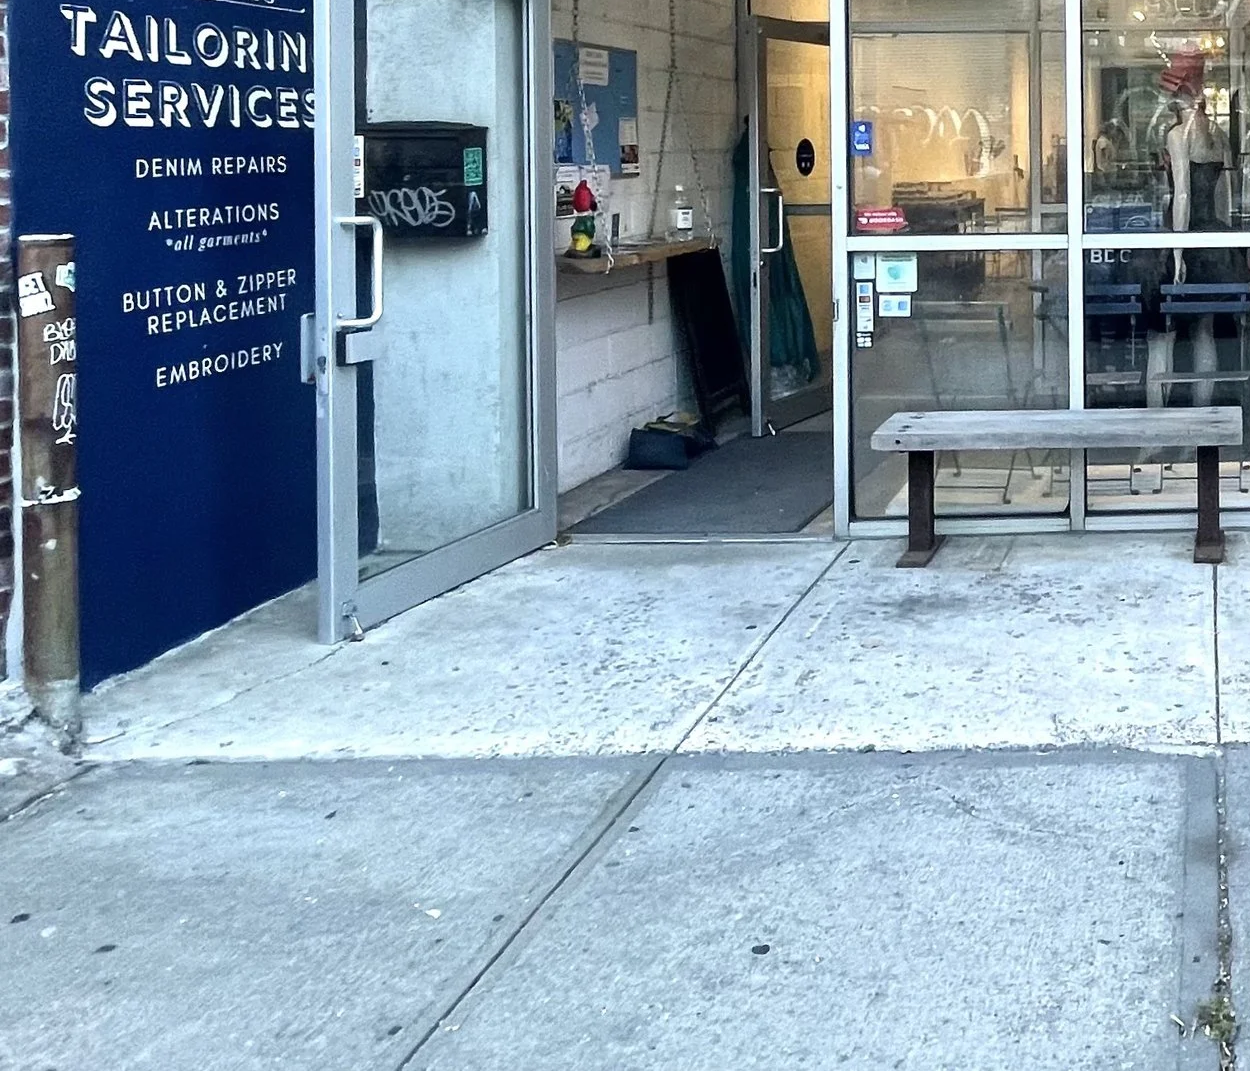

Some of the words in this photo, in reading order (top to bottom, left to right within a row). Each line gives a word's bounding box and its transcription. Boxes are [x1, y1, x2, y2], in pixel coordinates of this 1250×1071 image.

[59, 3, 315, 74] TAILORIN
[84, 76, 316, 130] SERVICES
[135, 158, 203, 179] DENIM
[211, 155, 288, 175] REPAIRS
[147, 203, 280, 231] ALTERATIONS
[122, 282, 206, 313] BUTTON
[215, 279, 228, 299] &
[237, 268, 297, 295] ZIPPER
[147, 293, 287, 336] REPLACEMENT
[156, 342, 284, 388] EMBROIDERY
